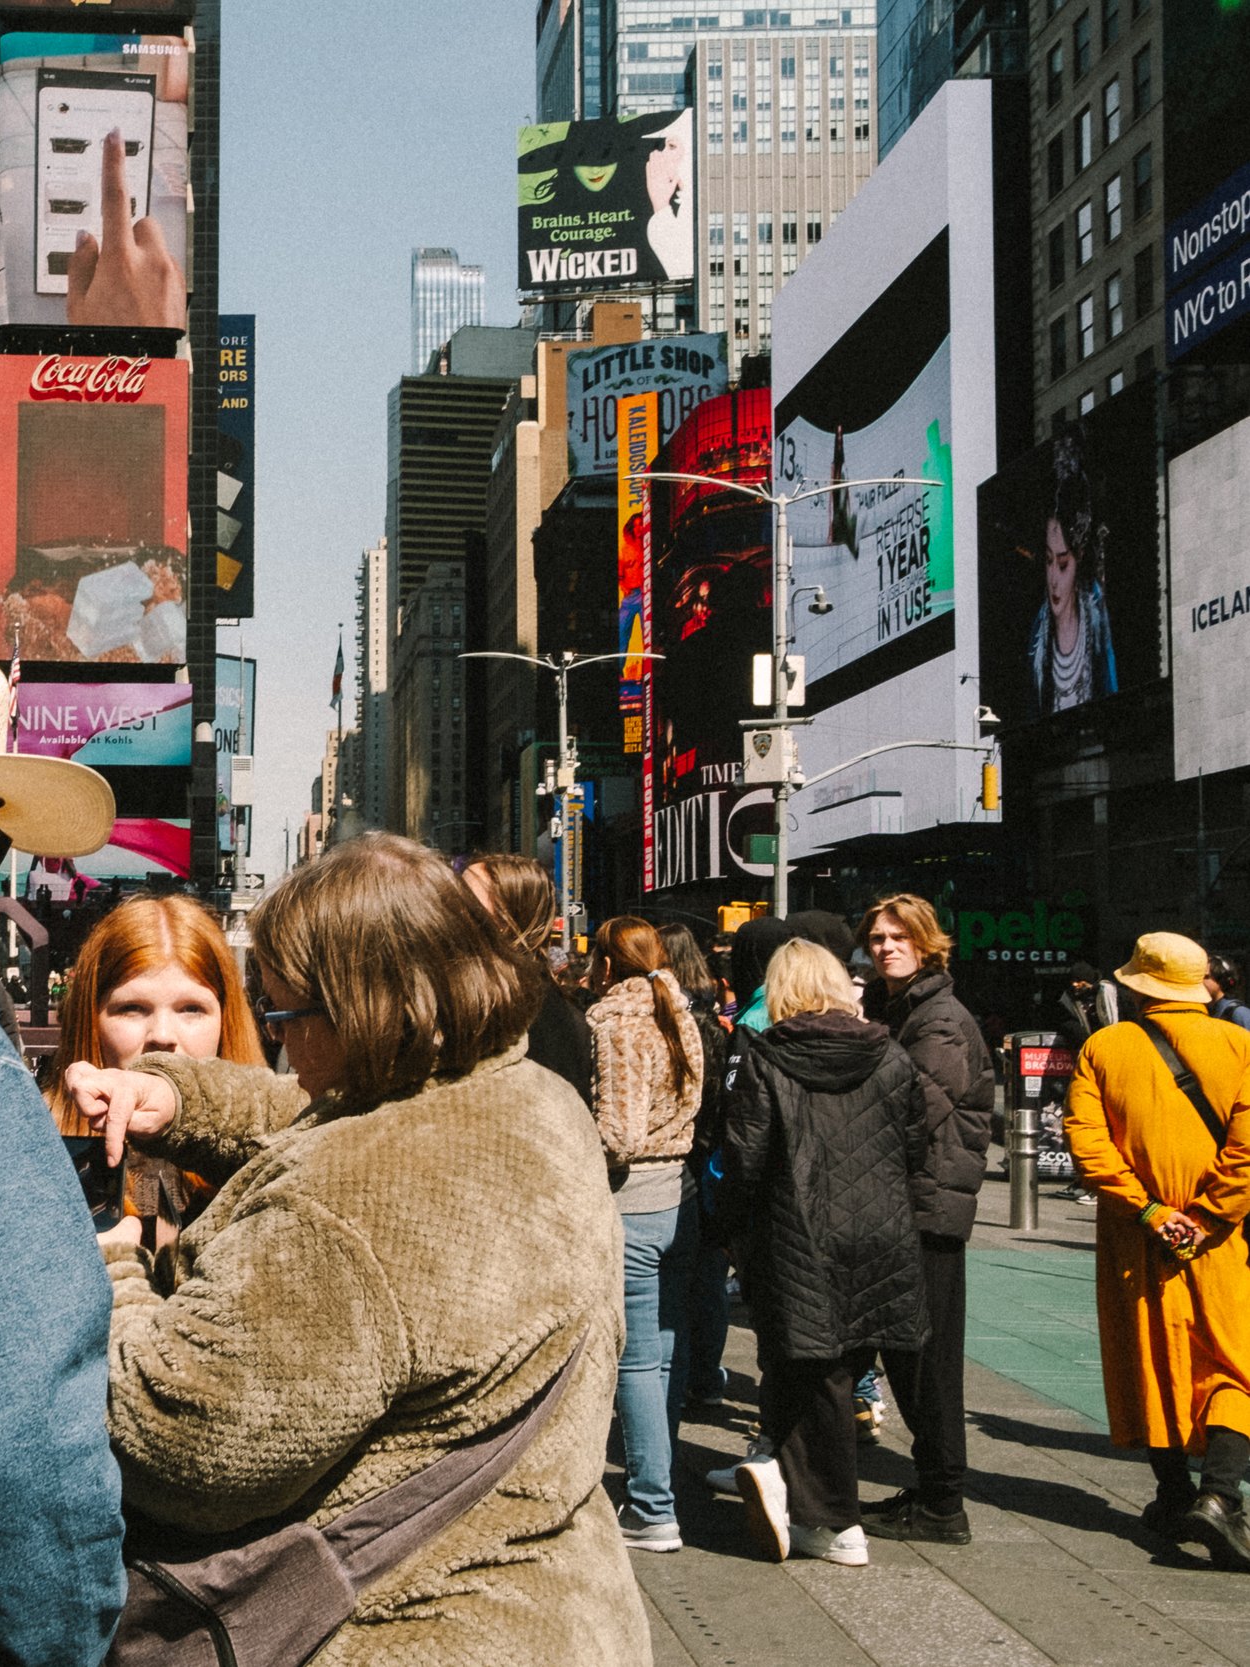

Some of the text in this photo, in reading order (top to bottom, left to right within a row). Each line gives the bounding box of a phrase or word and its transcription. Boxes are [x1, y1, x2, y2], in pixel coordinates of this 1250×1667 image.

[122, 43, 181, 56] SAMSUNG
[532, 209, 635, 230] Brains. Heart.
[550, 227, 617, 242] Courage.
[1174, 285, 1215, 345] NYC
[1217, 280, 1237, 314] to
[220, 349, 247, 366] RE
[582, 345, 715, 393] LITTLE SHOP
[30, 354, 151, 400] Coca-Cola
[628, 404, 647, 508] KALEIDOSOPE
[876, 491, 930, 556] REVERSE
[876, 525, 931, 591] 1 YEAR
[877, 606, 891, 642] IN
[18, 705, 163, 731] NINE WEST
[39, 735, 133, 745] Available at Kohls
[643, 773, 653, 839] COME
[987, 950, 1067, 962] SOCCER
[1024, 1052, 1072, 1061] MUSEUM
[1024, 1061, 1074, 1070] BROADW
